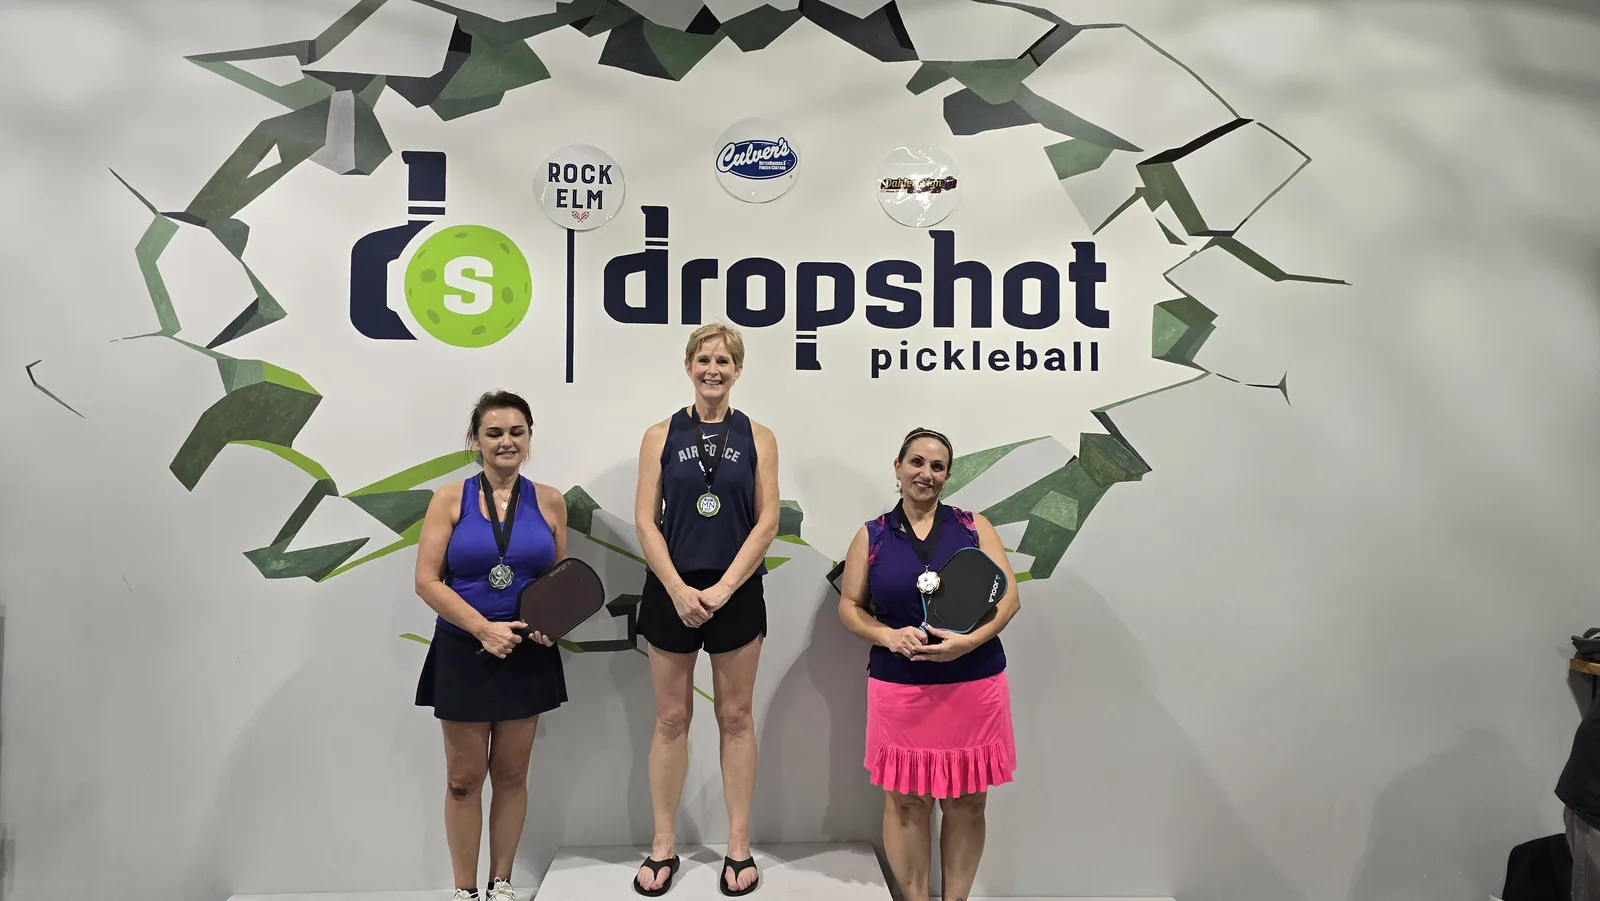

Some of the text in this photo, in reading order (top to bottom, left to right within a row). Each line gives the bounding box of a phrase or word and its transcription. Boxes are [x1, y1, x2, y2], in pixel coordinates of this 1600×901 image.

[717, 138, 790, 172] Culver's
[548, 163, 613, 185] ROCK
[556, 189, 603, 210] ELM
[604, 206, 1110, 370] dropshot
[872, 341, 1099, 379] pickleball
[678, 444, 741, 463] AIR FOCE
[988, 580, 999, 602] JOOLA
